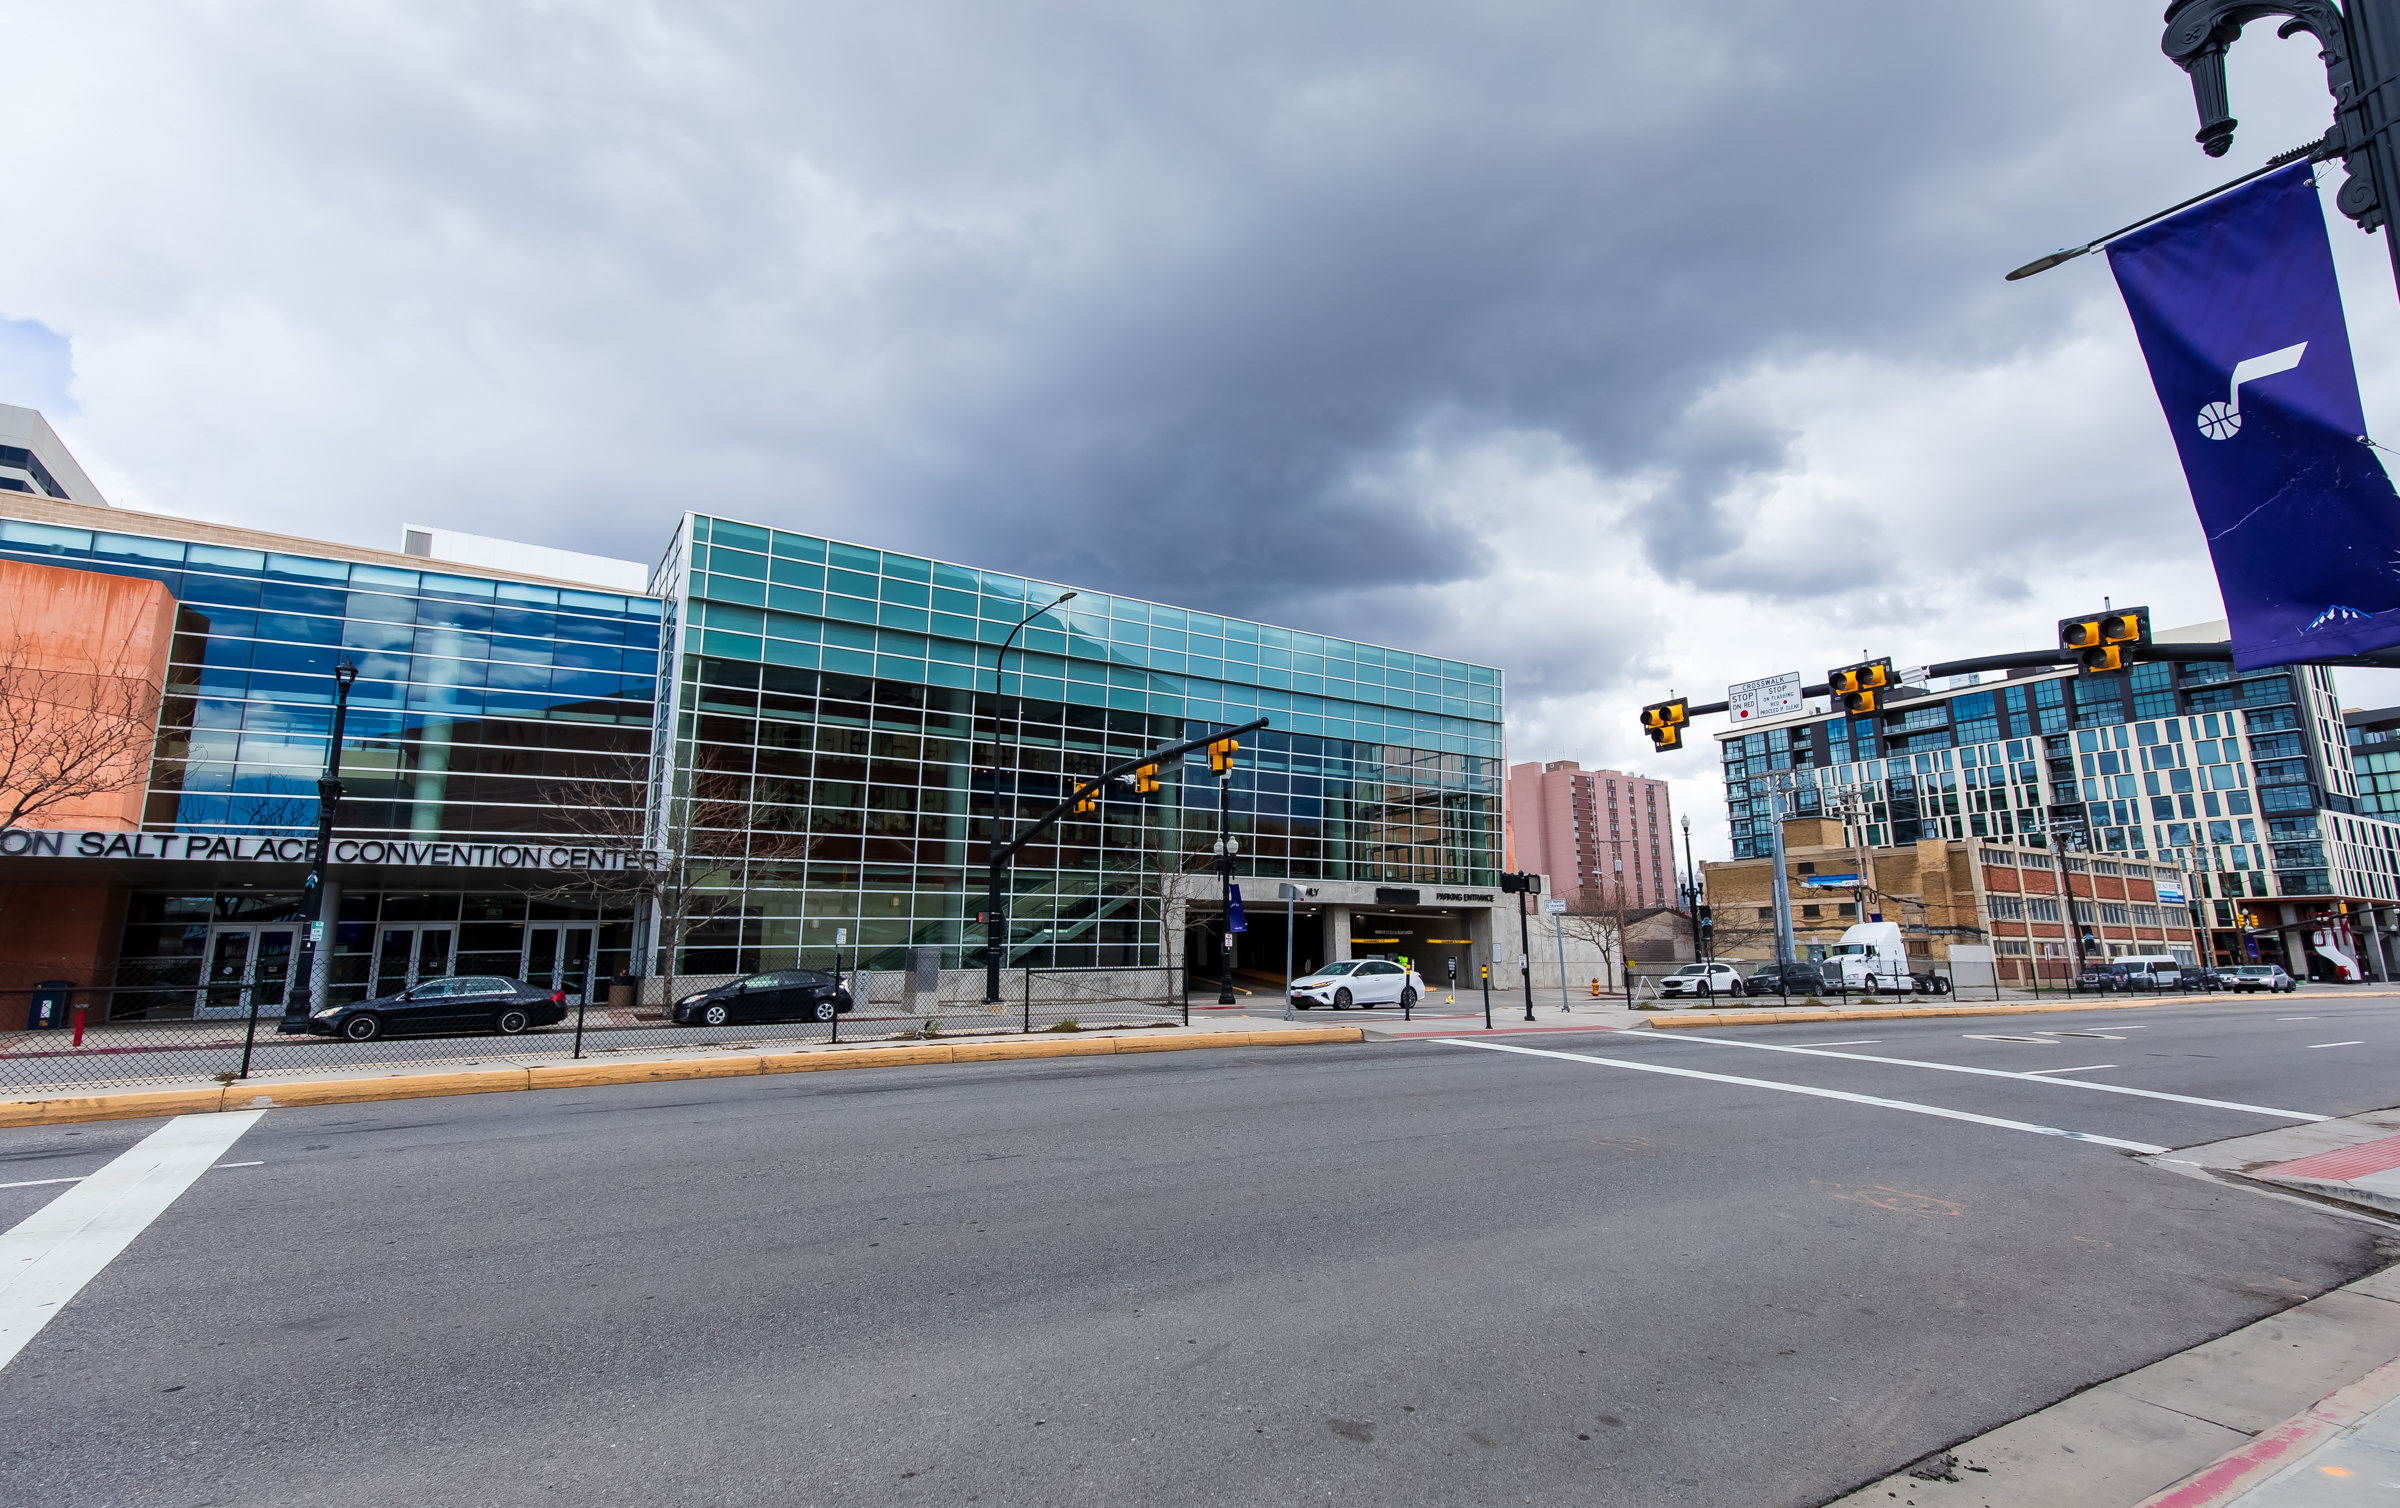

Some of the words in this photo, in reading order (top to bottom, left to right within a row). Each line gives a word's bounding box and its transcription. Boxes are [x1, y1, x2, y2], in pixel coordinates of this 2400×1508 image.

[1742, 677, 1784, 690] CROSSWALK
[1768, 685, 1787, 695] STOP
[1732, 692, 1753, 703] STOP
[1771, 692, 1794, 701] FLASHING
[1786, 703, 1800, 711] CLEAR
[76, 831, 180, 859] SALT
[185, 834, 319, 862] PALACE
[335, 840, 541, 868] CONVENTION
[549, 846, 659, 871] CENTER
[1305, 887, 1319, 897] NLY
[1436, 892, 1462, 902] PARKING
[1463, 893, 1496, 903] ENTRANCE
